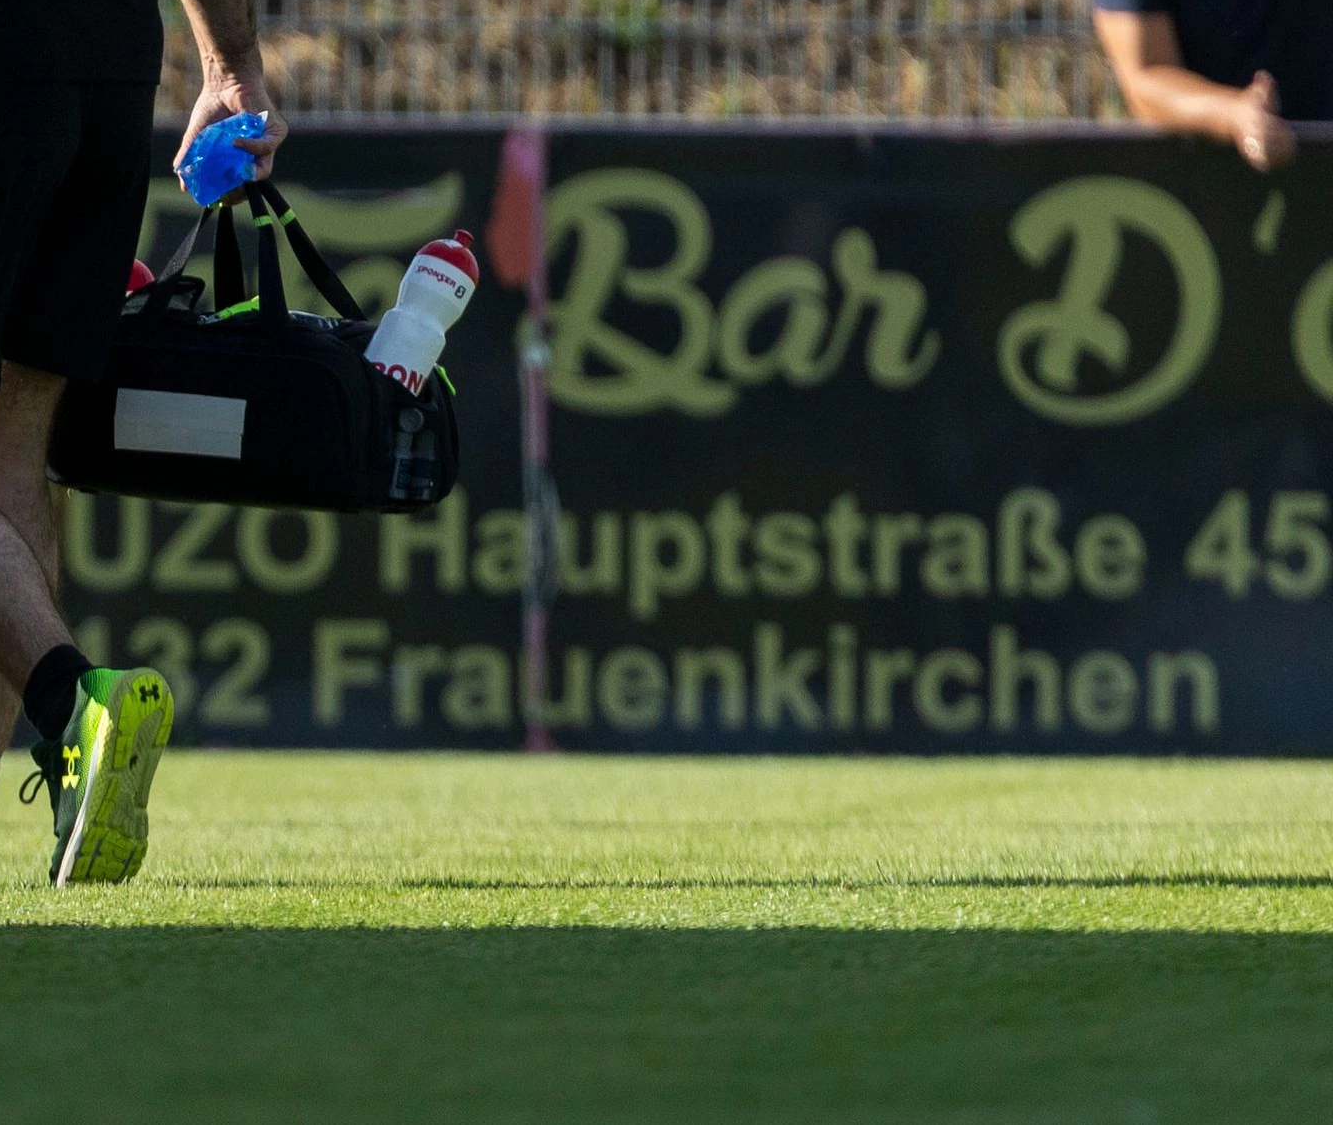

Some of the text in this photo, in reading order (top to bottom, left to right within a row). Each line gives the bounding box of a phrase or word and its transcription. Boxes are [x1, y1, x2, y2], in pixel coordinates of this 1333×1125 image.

[416, 264, 458, 289] SPONSER
[517, 167, 942, 418] Bar
[379, 485, 1148, 623] Hauptstraße
[1185, 488, 1333, 602] 45
[313, 619, 1223, 735] Frauenkirchen
